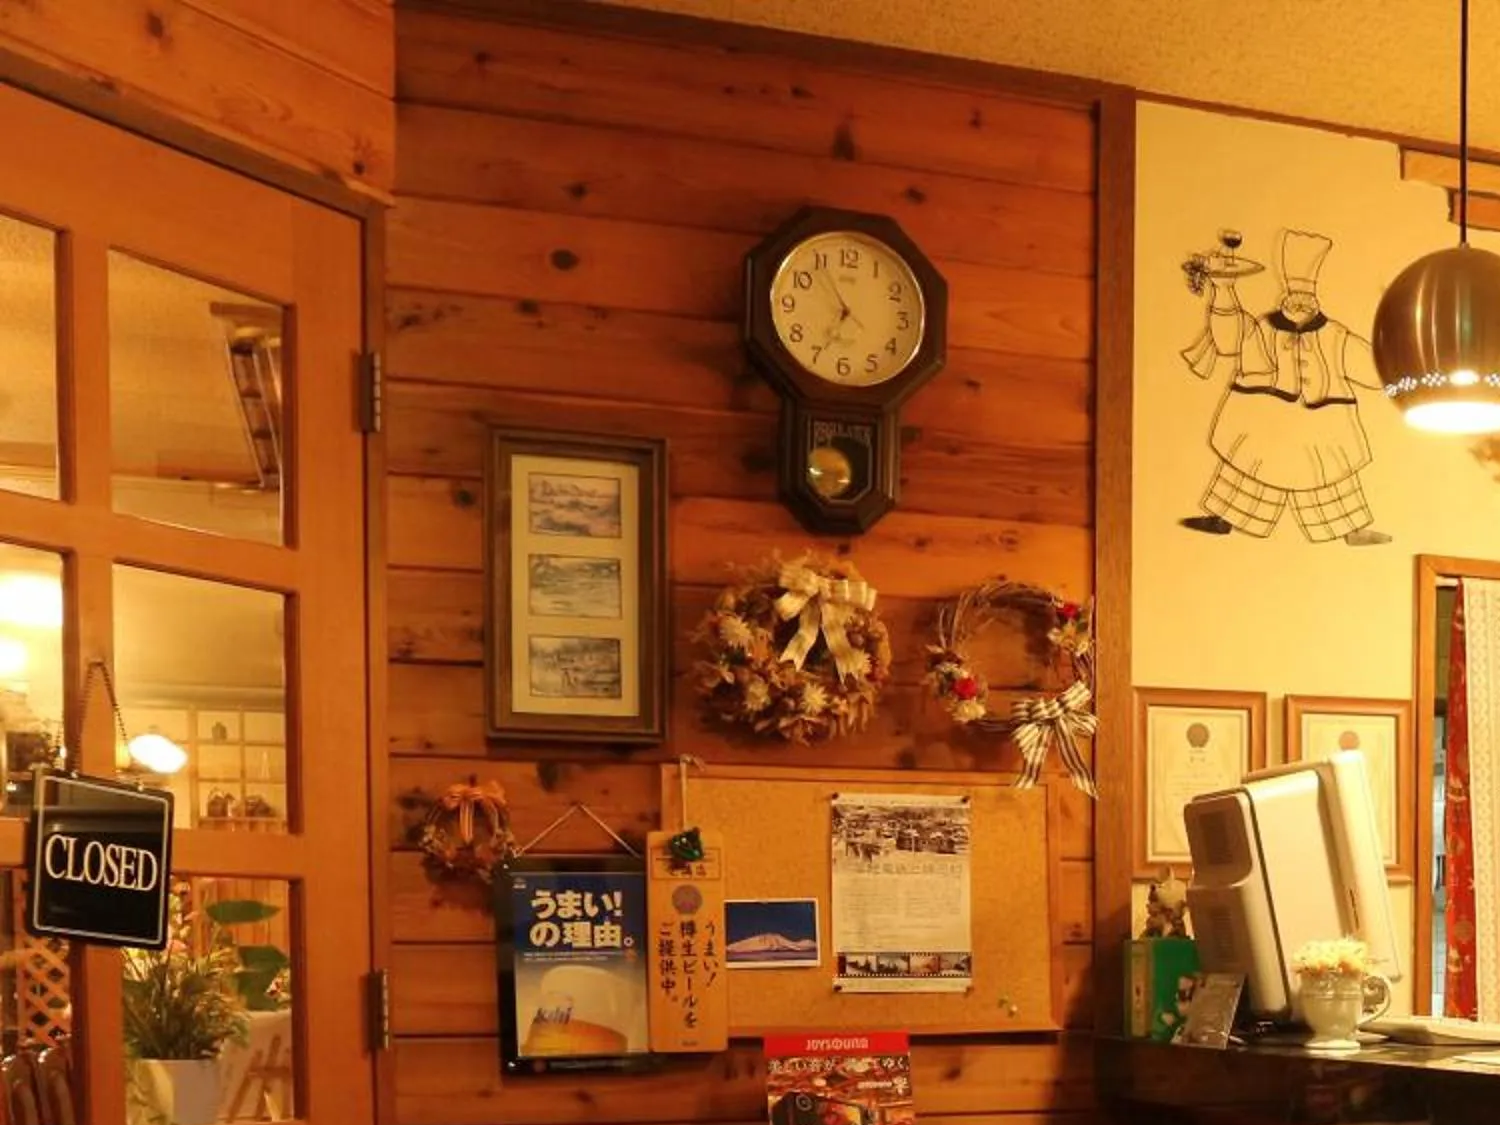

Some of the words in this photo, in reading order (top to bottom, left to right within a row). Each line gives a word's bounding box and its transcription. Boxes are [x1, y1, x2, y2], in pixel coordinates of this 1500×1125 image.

[815, 251, 828, 270] 11
[840, 248, 859, 269] 12
[872, 260, 879, 279] 1
[792, 271, 813, 290] 10
[888, 281, 902, 303] 2
[781, 294, 796, 313] 9
[896, 311, 909, 331] 3
[789, 323, 803, 343] 8
[811, 345, 823, 364] 7
[885, 336, 897, 355] 4
[837, 357, 850, 376] 6
[865, 353, 878, 373] 5
[45, 833, 158, 891] CLOSED
[530, 889, 623, 919] うまい!
[529, 920, 635, 948] の理由。
[806, 1037, 869, 1051] JOYSOUND
